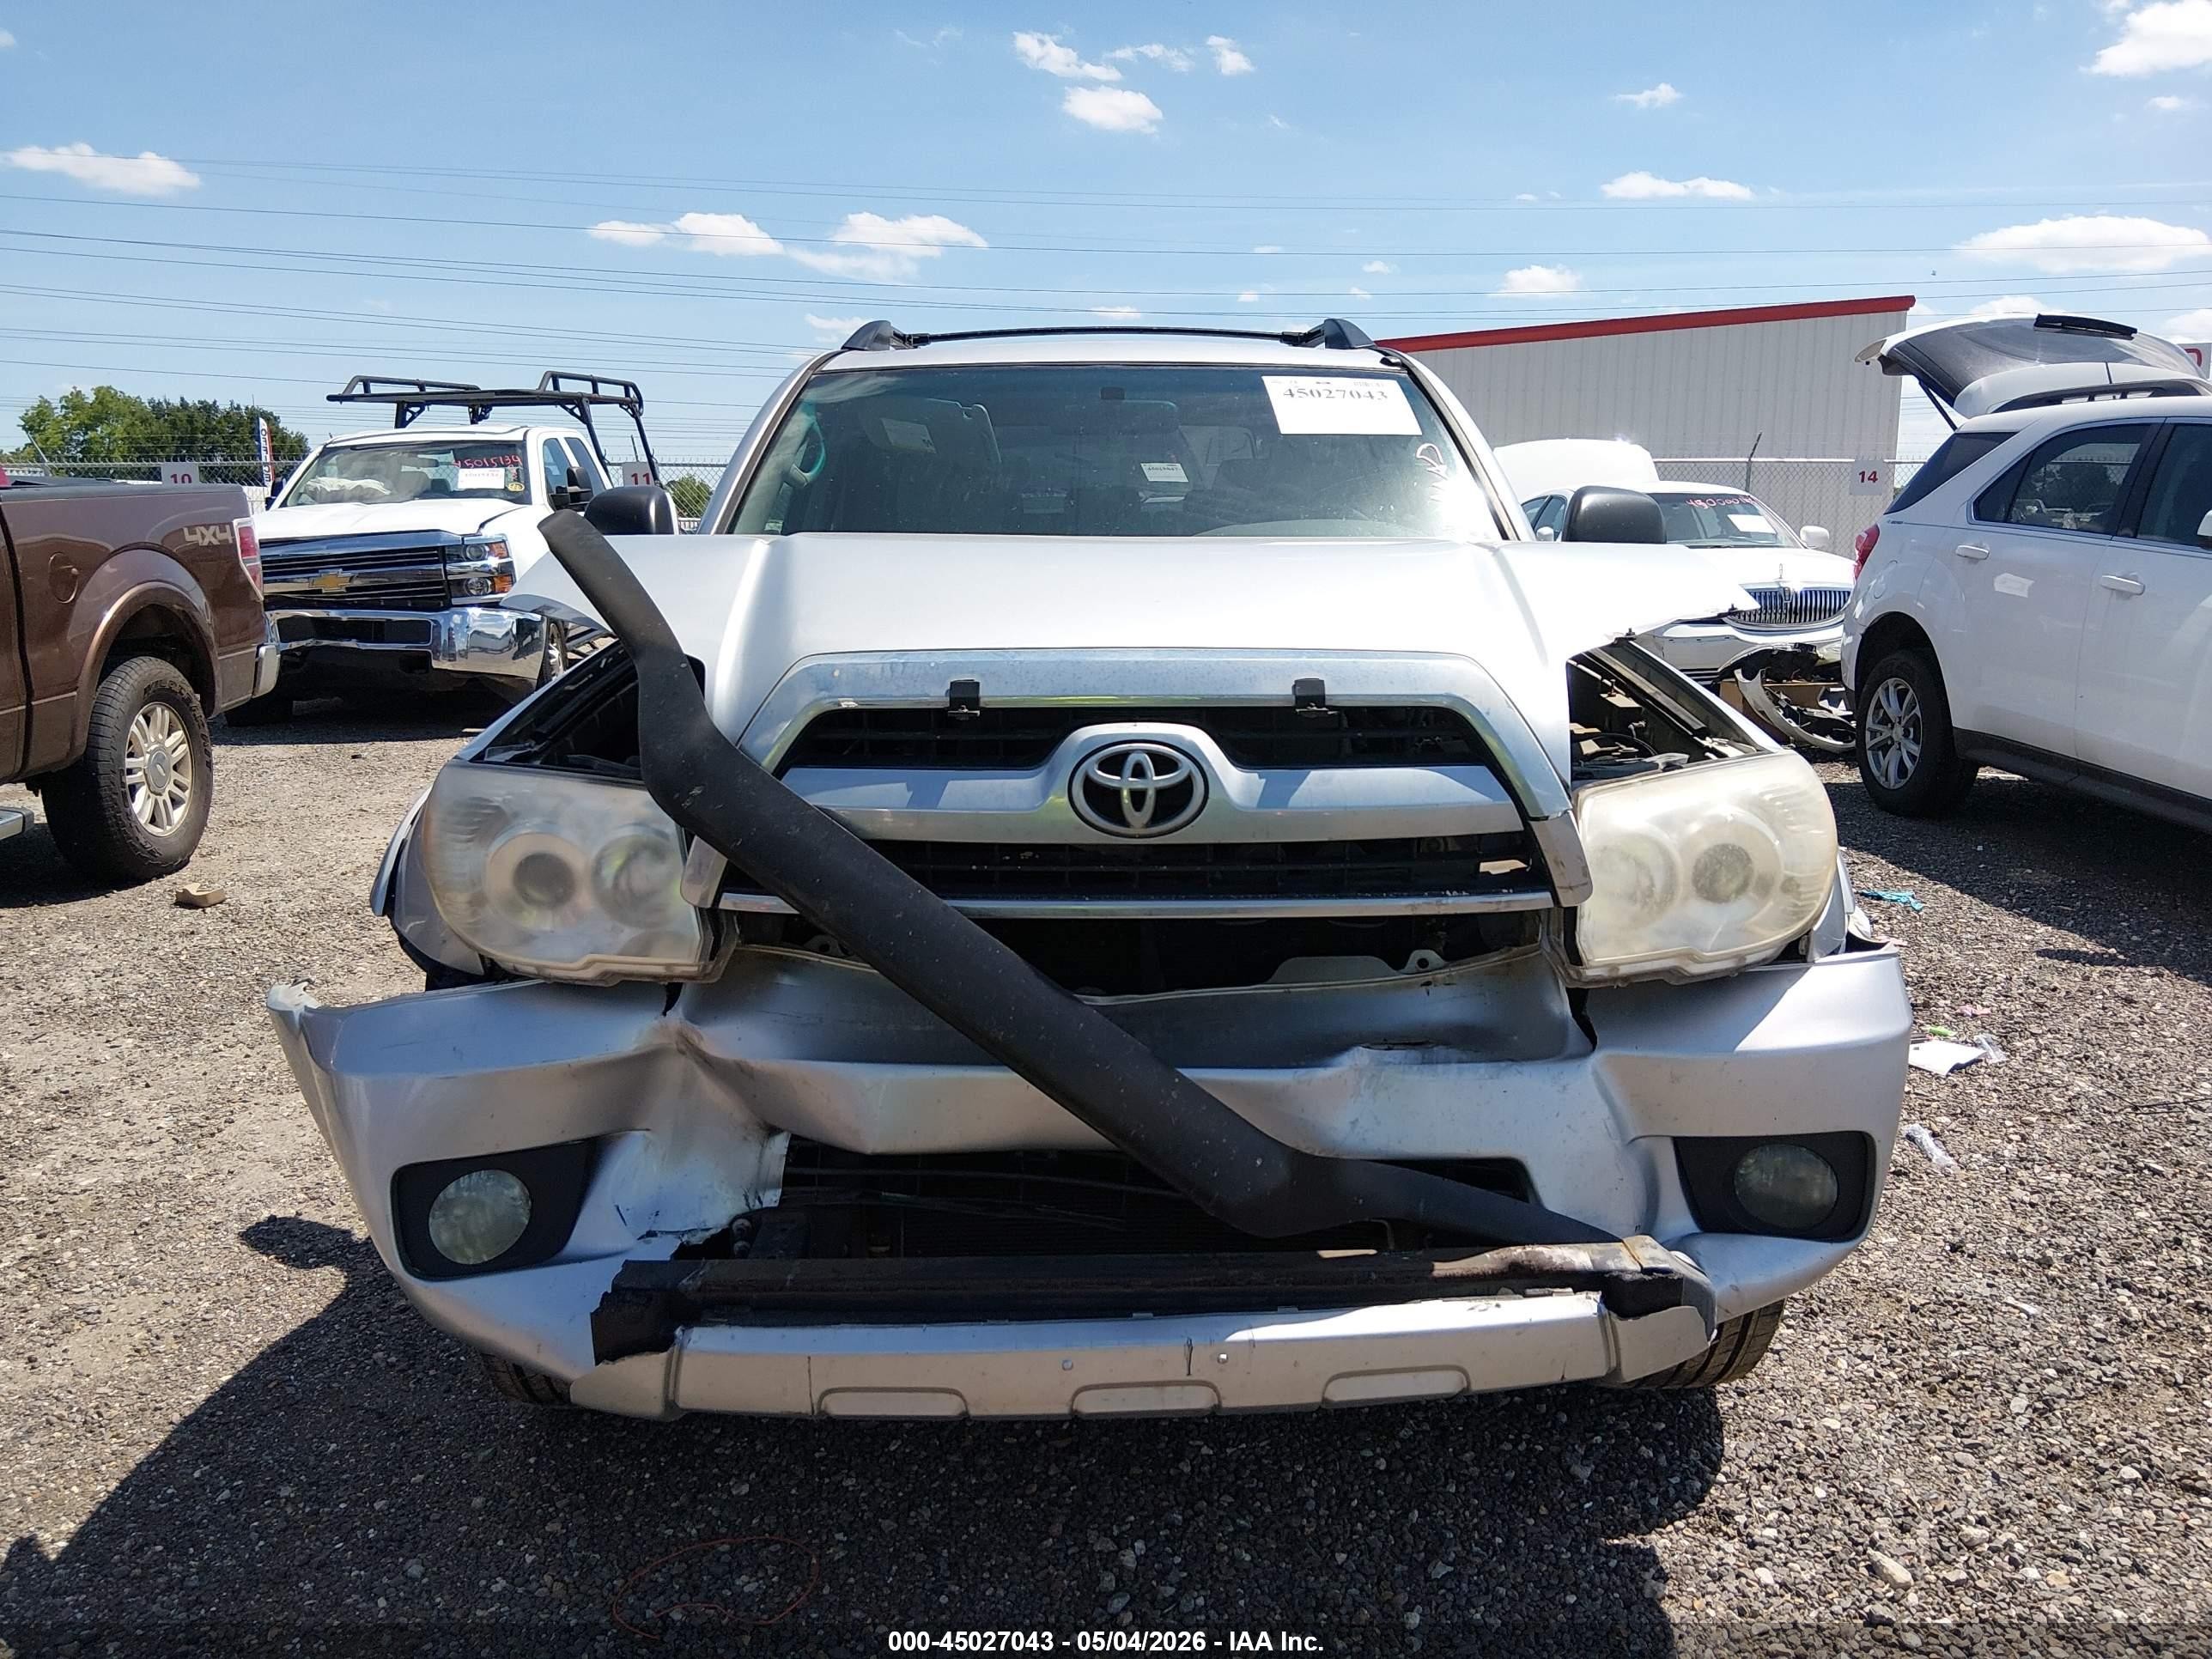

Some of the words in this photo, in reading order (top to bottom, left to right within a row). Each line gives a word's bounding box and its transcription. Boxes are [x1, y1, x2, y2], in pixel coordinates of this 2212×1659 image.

[1283, 387, 1389, 401] 45027043
[260, 428, 272, 483] OFFICE
[170, 473, 192, 484] 10
[631, 472, 651, 485] 11
[1858, 471, 1879, 483] 14
